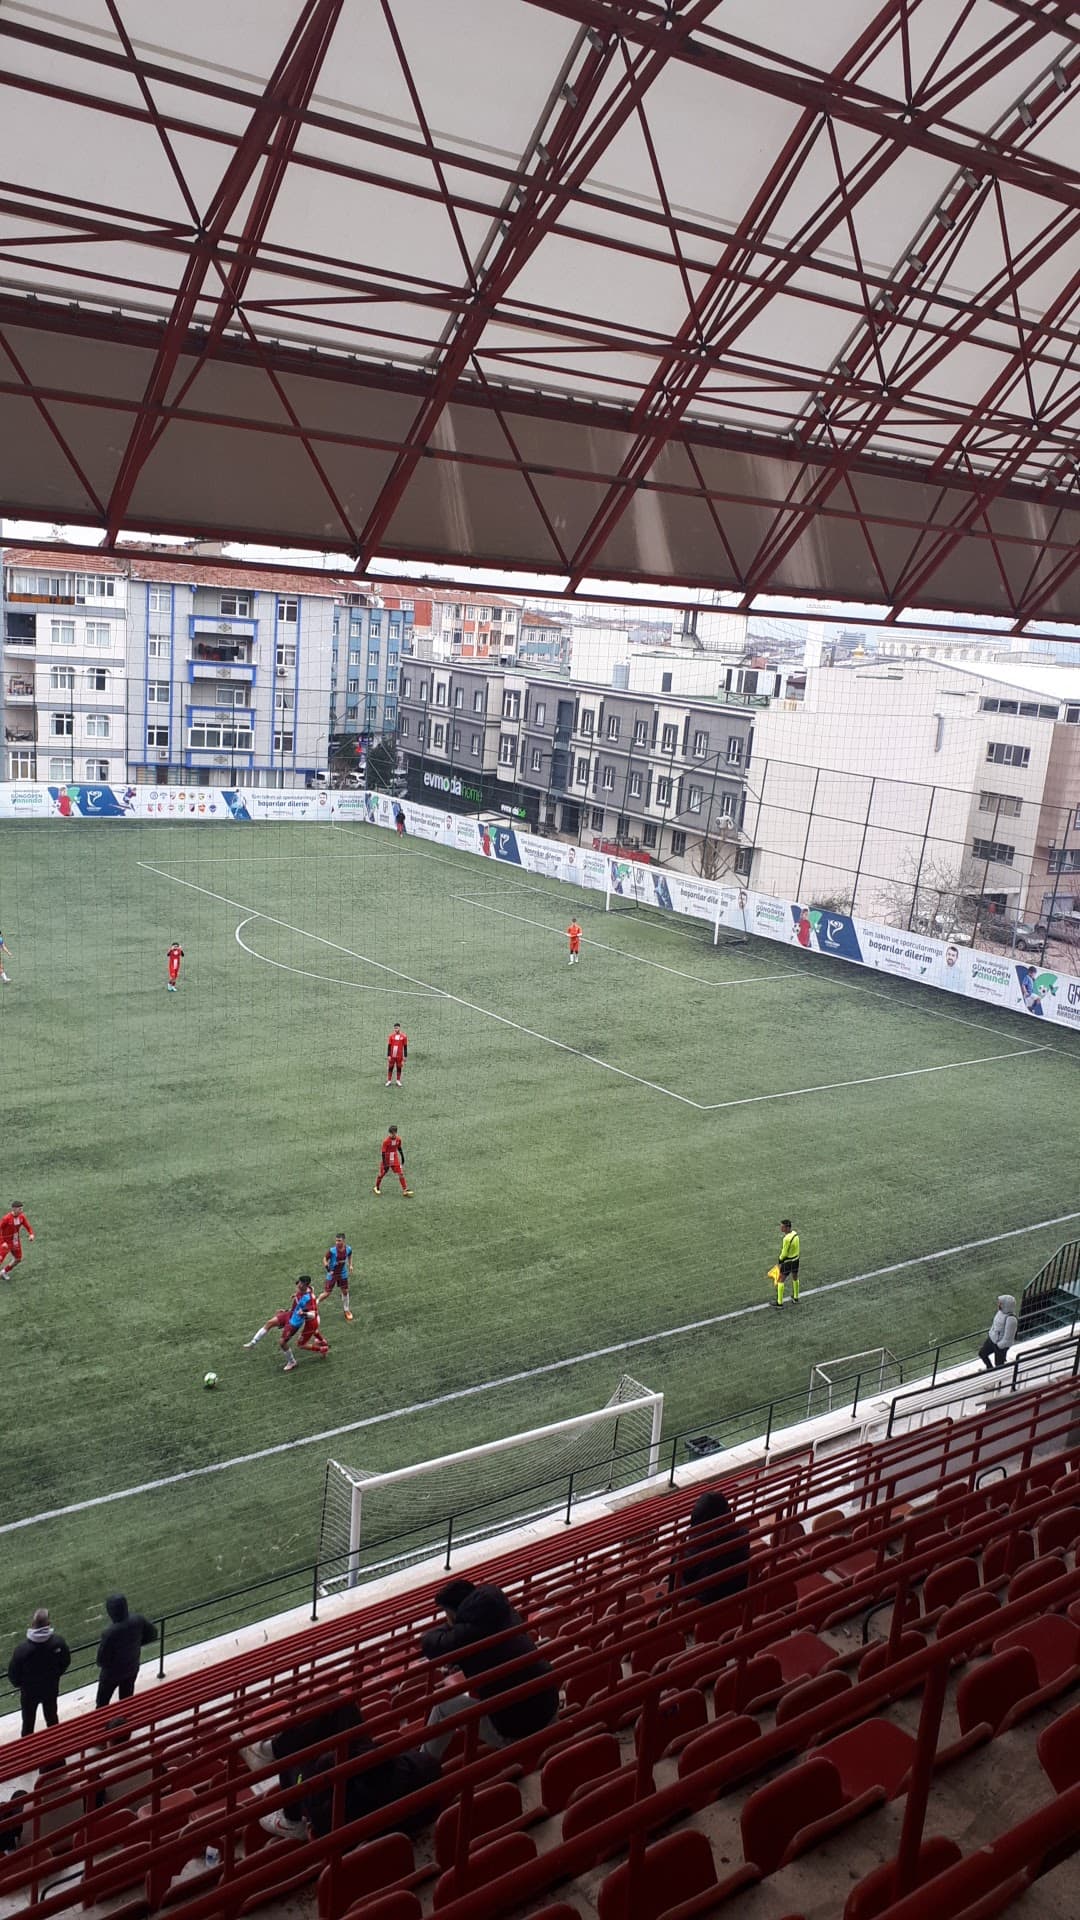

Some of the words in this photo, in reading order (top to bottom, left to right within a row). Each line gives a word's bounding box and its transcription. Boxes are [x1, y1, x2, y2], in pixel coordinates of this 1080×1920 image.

[869, 938, 903, 955] başarılar
[904, 949, 933, 964] dilerim
[972, 963, 1011, 979] GÜNGÖREN
